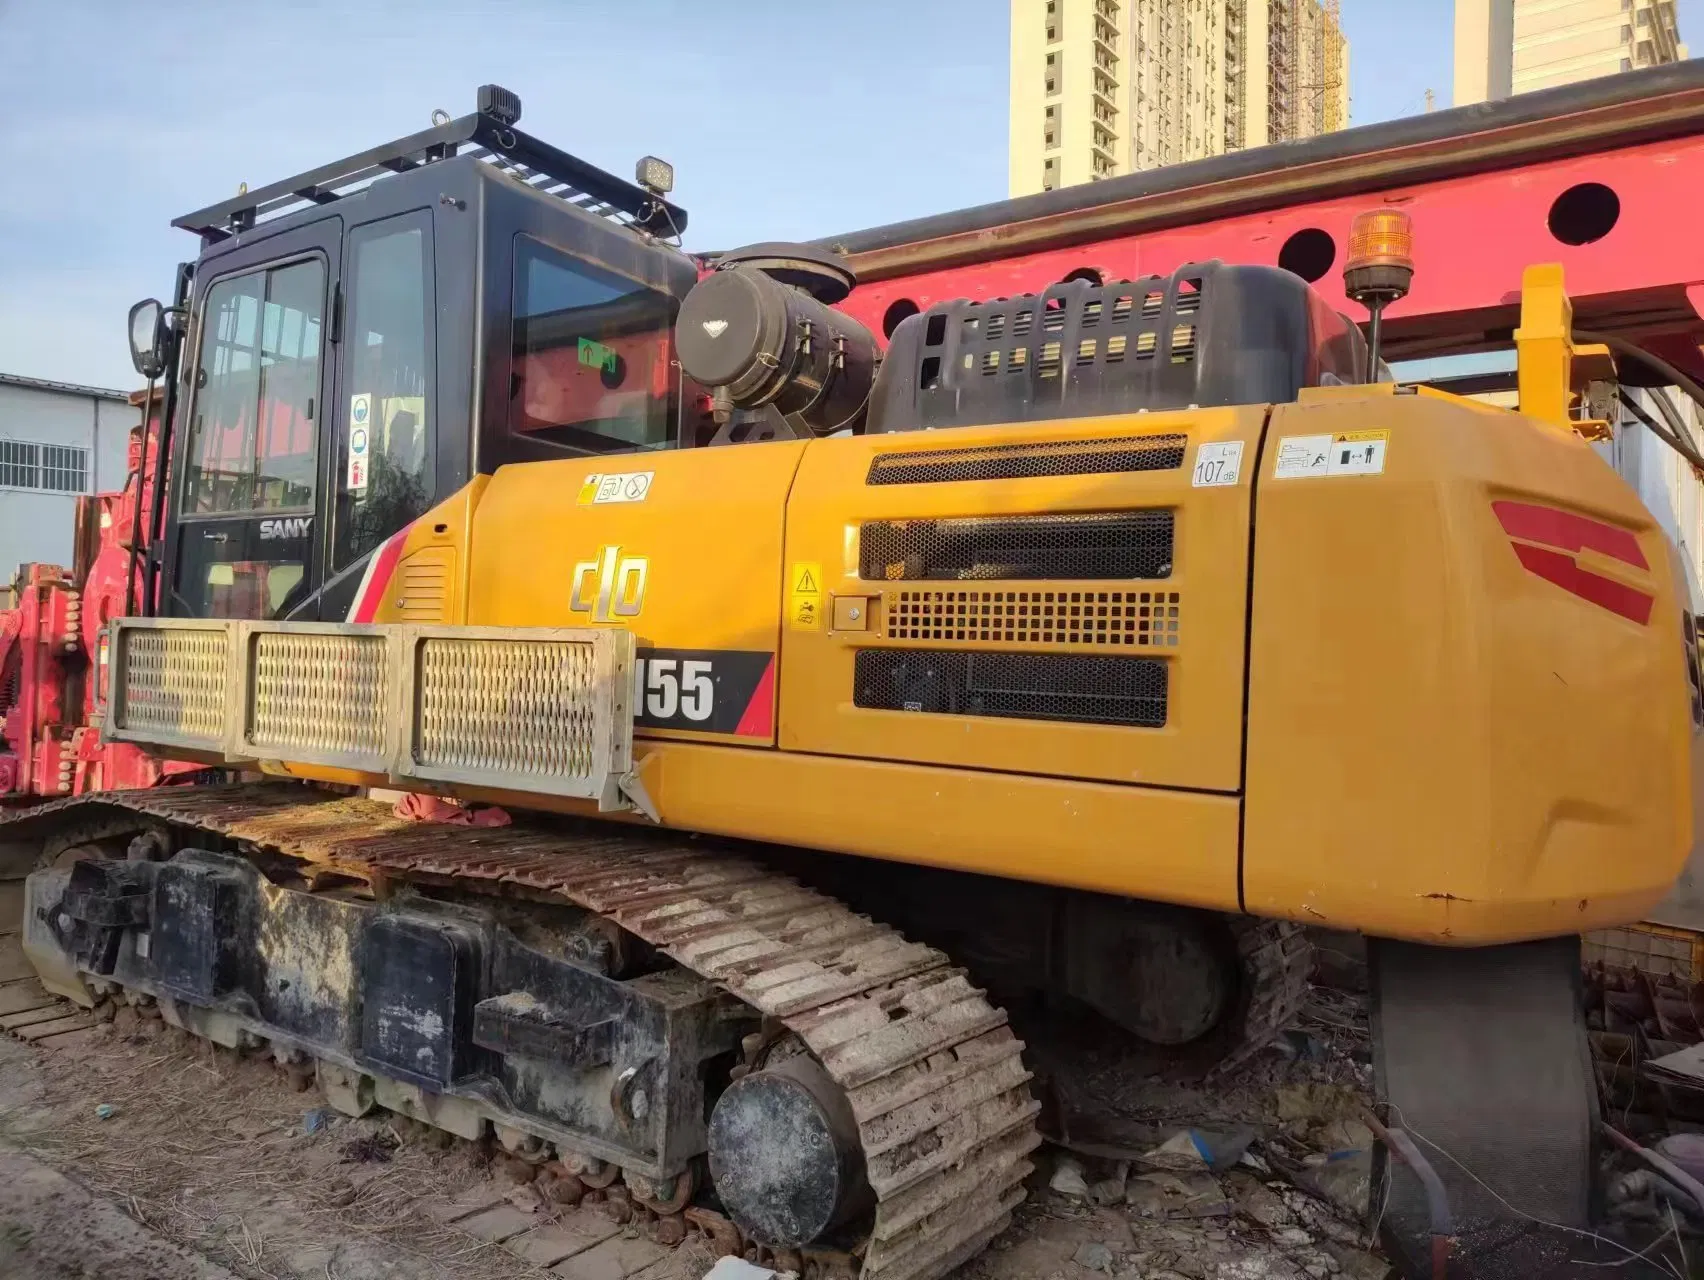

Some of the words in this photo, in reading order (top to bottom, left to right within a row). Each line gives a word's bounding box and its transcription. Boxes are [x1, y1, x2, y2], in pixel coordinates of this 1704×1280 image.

[1197, 460, 1225, 483] 107
[1224, 471, 1235, 481] dB
[260, 517, 313, 540] SANY
